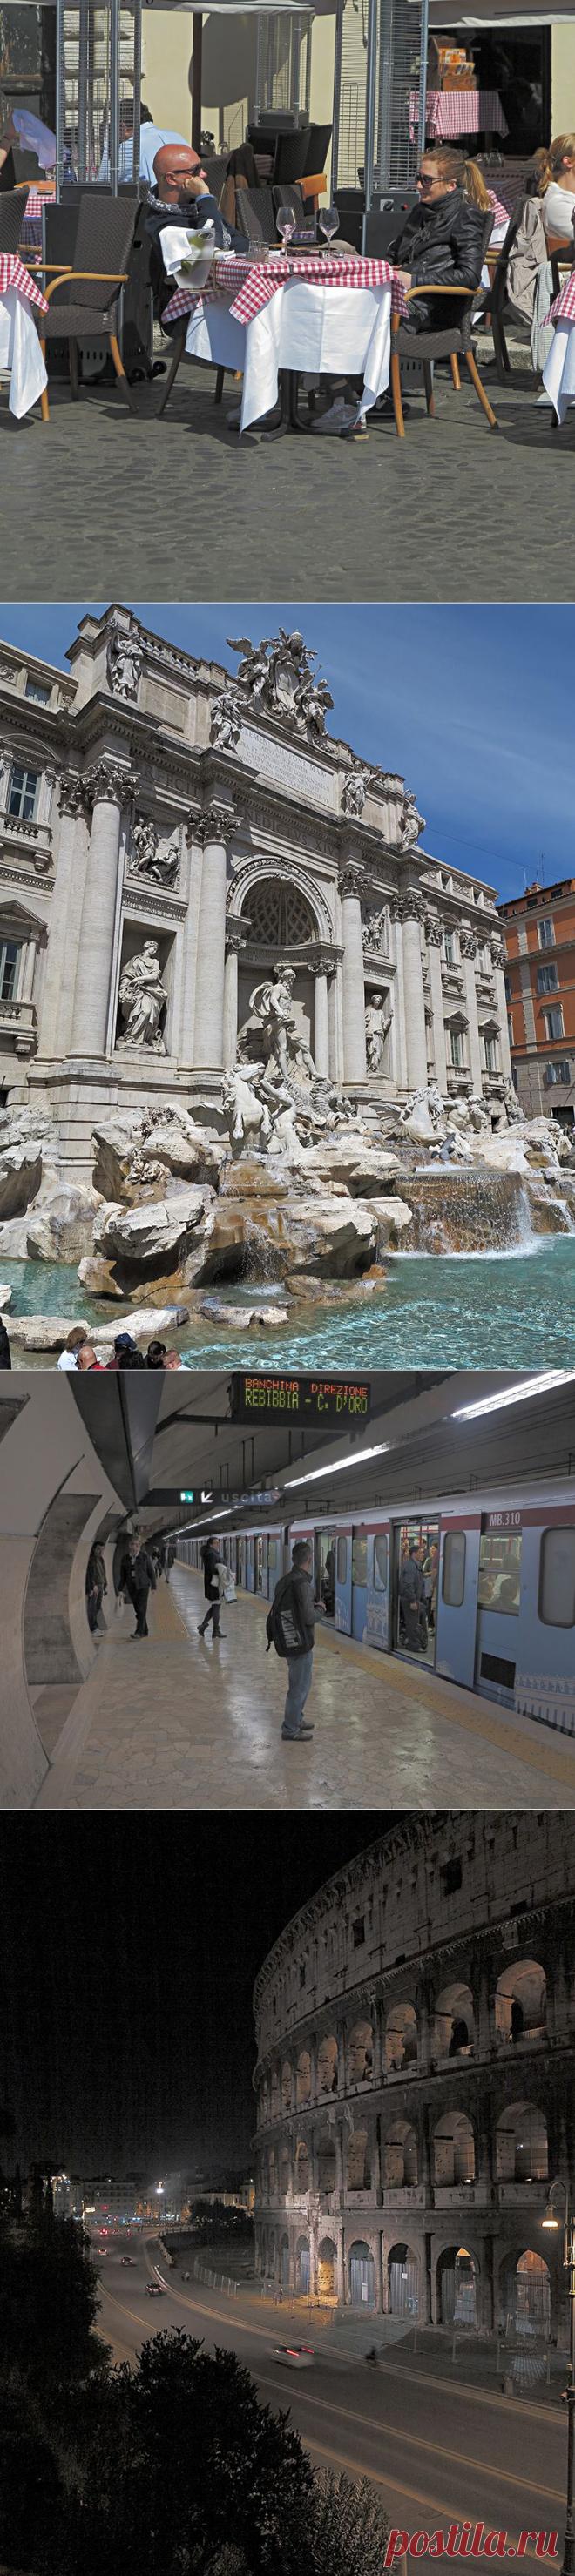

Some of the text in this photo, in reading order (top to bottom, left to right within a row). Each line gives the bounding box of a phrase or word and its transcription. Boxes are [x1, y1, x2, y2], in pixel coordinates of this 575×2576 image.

[245, 1378, 368, 1397] BANCHINA DIREZIONE
[245, 1388, 299, 1409] REBIBBIA
[336, 1394, 368, 1413] D'ORO
[221, 1493, 272, 1503] uscita
[490, 1512, 521, 1527] MB.310
